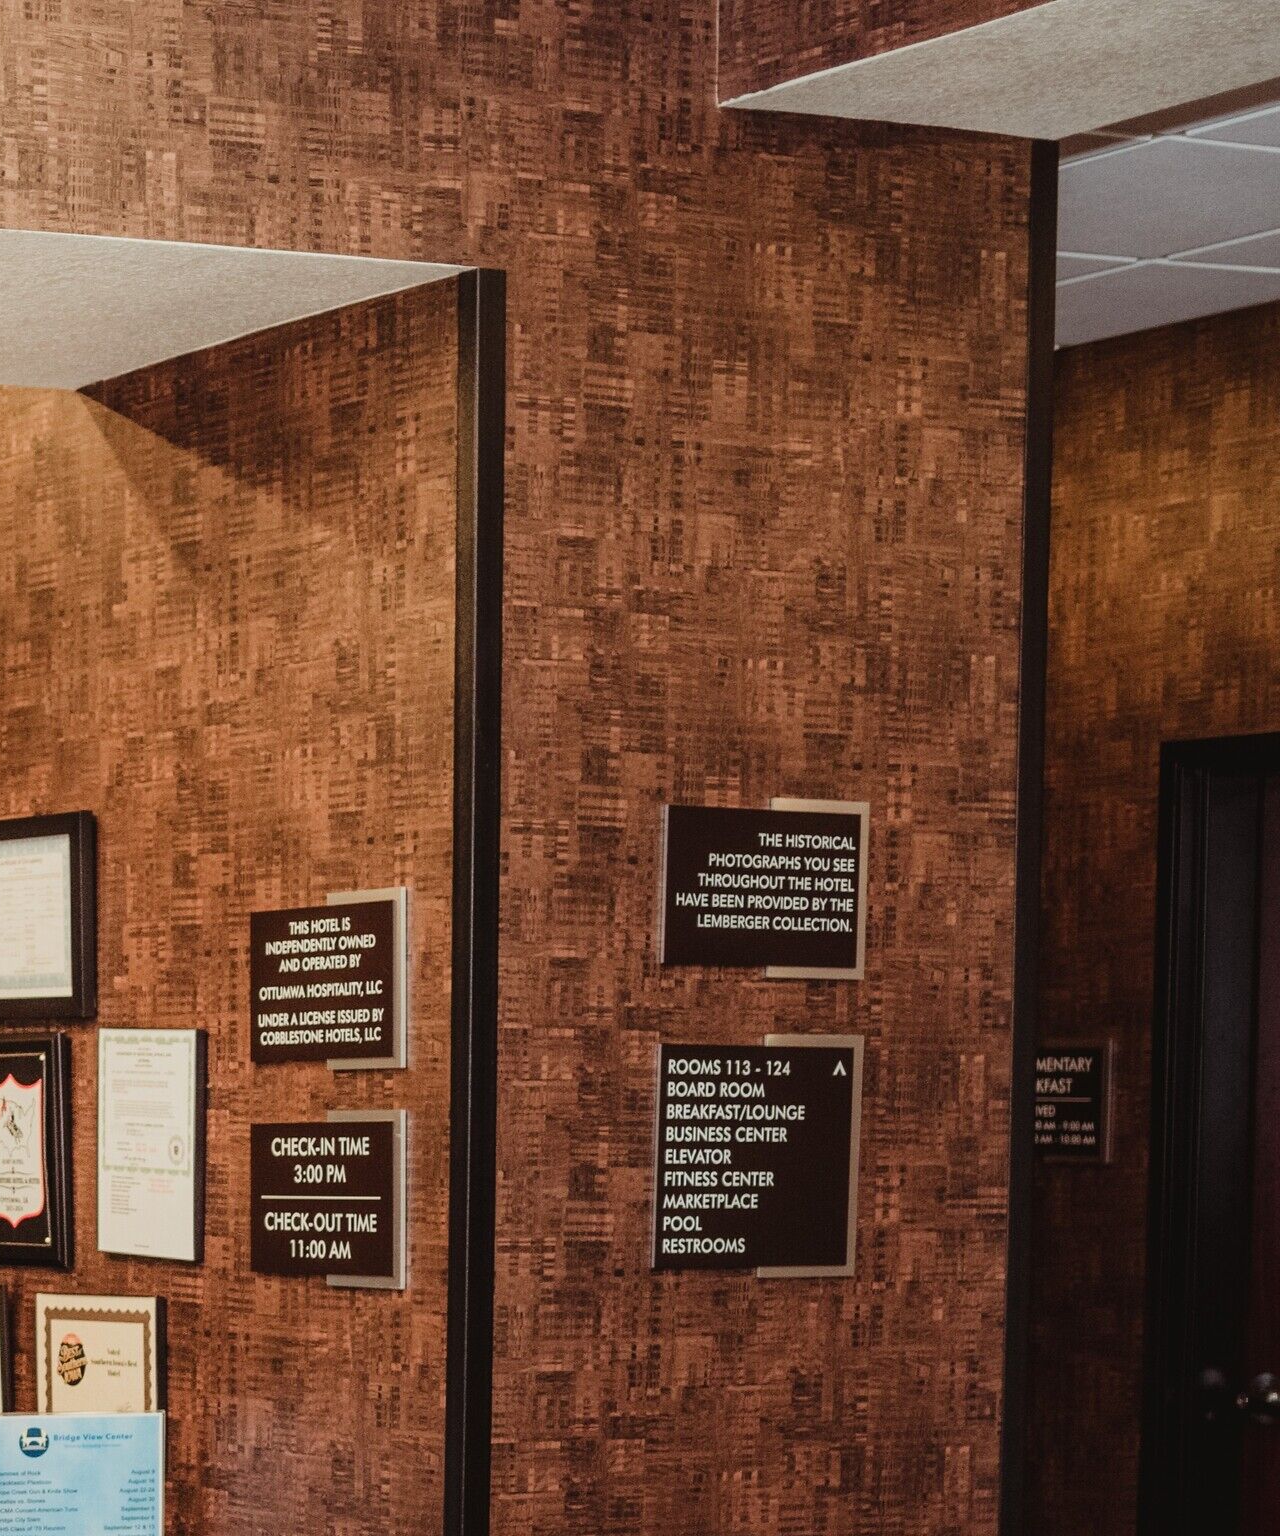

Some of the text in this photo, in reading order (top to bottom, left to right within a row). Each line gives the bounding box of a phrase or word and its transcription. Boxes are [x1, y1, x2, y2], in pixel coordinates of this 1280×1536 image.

[758, 832, 856, 850] THE HISTORICAL
[708, 852, 855, 873] PHOTOGRAPHS YOU SEE
[697, 872, 855, 892] THROUGHOUT THE HOTEL
[675, 892, 854, 912] HAVE BEEN PROVIDED BY THE
[289, 917, 351, 935] THIS HOTEL IS
[696, 913, 853, 932] LEMBERGER COLLECTION.
[265, 933, 376, 956] INDEPENDENTLY OWNED
[278, 953, 362, 973] AND OPERATED BY
[258, 980, 383, 1001] OTTUMWA HOSPITALITY, LLC
[258, 1008, 385, 1028] UNDER A LICENSE ISSUED BY
[260, 1027, 382, 1046] COBBLESTONE HOTELS, LLC
[668, 1058, 721, 1076] ROOMS
[726, 1060, 751, 1076] 113
[766, 1061, 791, 1076] 124
[667, 1081, 765, 1098] BOARD ROOM
[666, 1103, 806, 1121] BREAKFAST/LOUNGE
[665, 1126, 788, 1143] BUSINESS CENTER
[271, 1136, 370, 1157] CHECK-IN TIME
[664, 1148, 732, 1165] ELEVATOR
[293, 1164, 347, 1183] 3:00 PM
[664, 1170, 775, 1187] FITNESS CENTER
[663, 1193, 759, 1210] MARKETPLACE
[264, 1211, 378, 1233] CHECK-OUT TIME
[662, 1215, 703, 1232] POOL
[290, 1239, 352, 1259] 11:00 AM
[662, 1237, 746, 1254] RESTROOMS
[53, 1433, 81, 1442] Bridge
